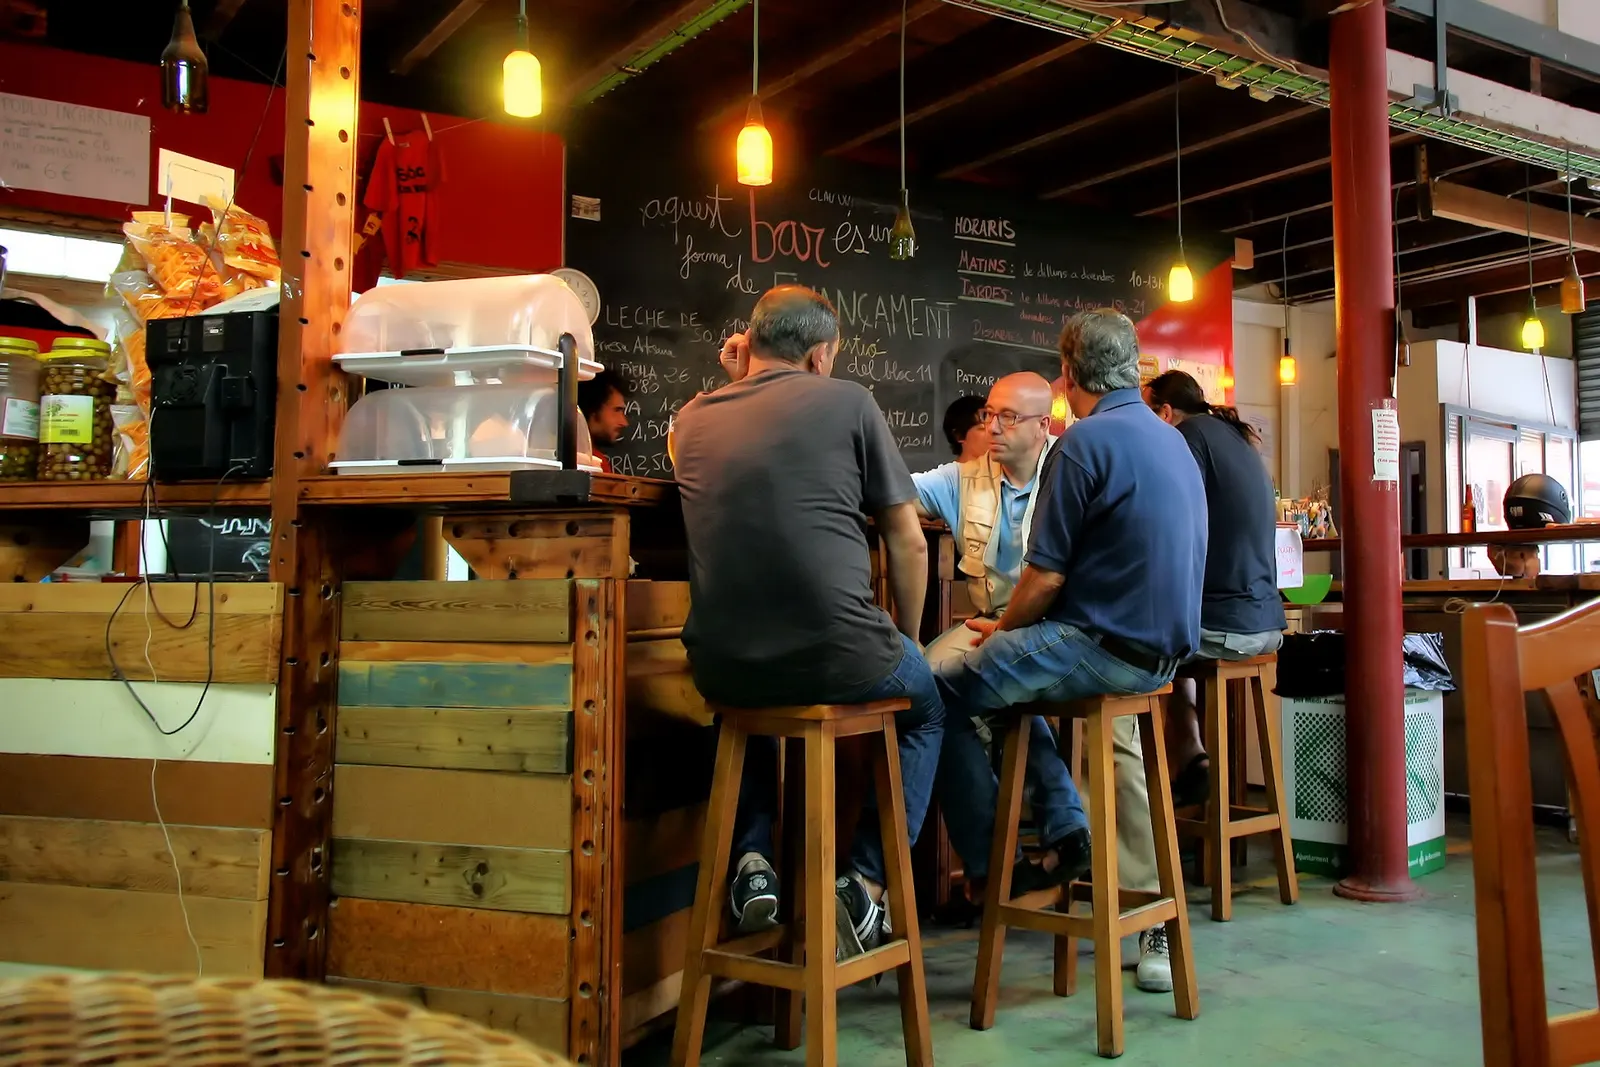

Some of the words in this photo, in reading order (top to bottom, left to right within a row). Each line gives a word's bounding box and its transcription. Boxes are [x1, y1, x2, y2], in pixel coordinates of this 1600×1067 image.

[639, 183, 742, 245] aquest
[749, 186, 830, 268] bar
[954, 216, 1016, 240] HORARIS
[680, 234, 733, 280] forma
[726, 254, 760, 295] de
[606, 304, 671, 329] LECHE
[680, 312, 703, 328] DE
[847, 356, 881, 382] del
[956, 368, 1001, 387] PATXAR
